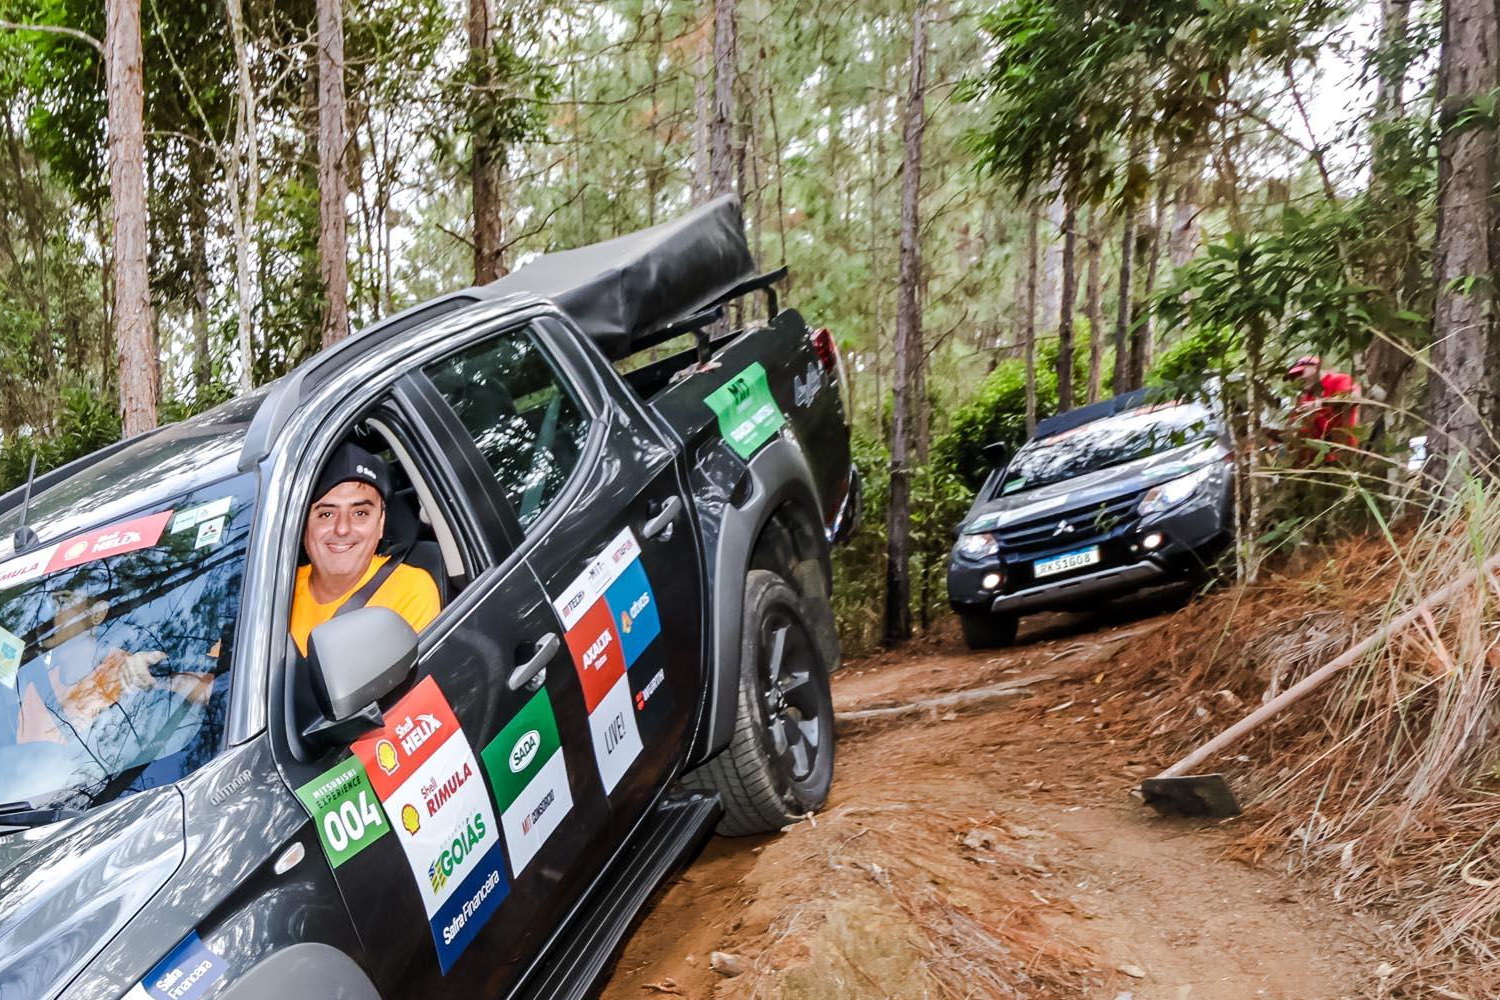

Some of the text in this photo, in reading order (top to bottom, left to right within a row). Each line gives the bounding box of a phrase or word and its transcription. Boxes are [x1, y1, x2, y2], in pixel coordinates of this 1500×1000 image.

[395, 715, 414, 741] Shell
[400, 713, 443, 756] HELIX
[604, 711, 627, 755] LIVE!
[512, 735, 538, 767] SADA
[211, 769, 253, 806] OUTDOOR
[312, 768, 357, 799] MITSUBISHI
[316, 775, 362, 809] EXPERIENCE
[420, 777, 439, 800] Shell
[425, 761, 473, 818] RIMULA
[323, 790, 383, 852] 004
[438, 811, 487, 878] GOIÁS
[442, 869, 500, 946] Safra Financeira
[156, 968, 184, 992] Safra
[167, 958, 213, 1000] Financeira
